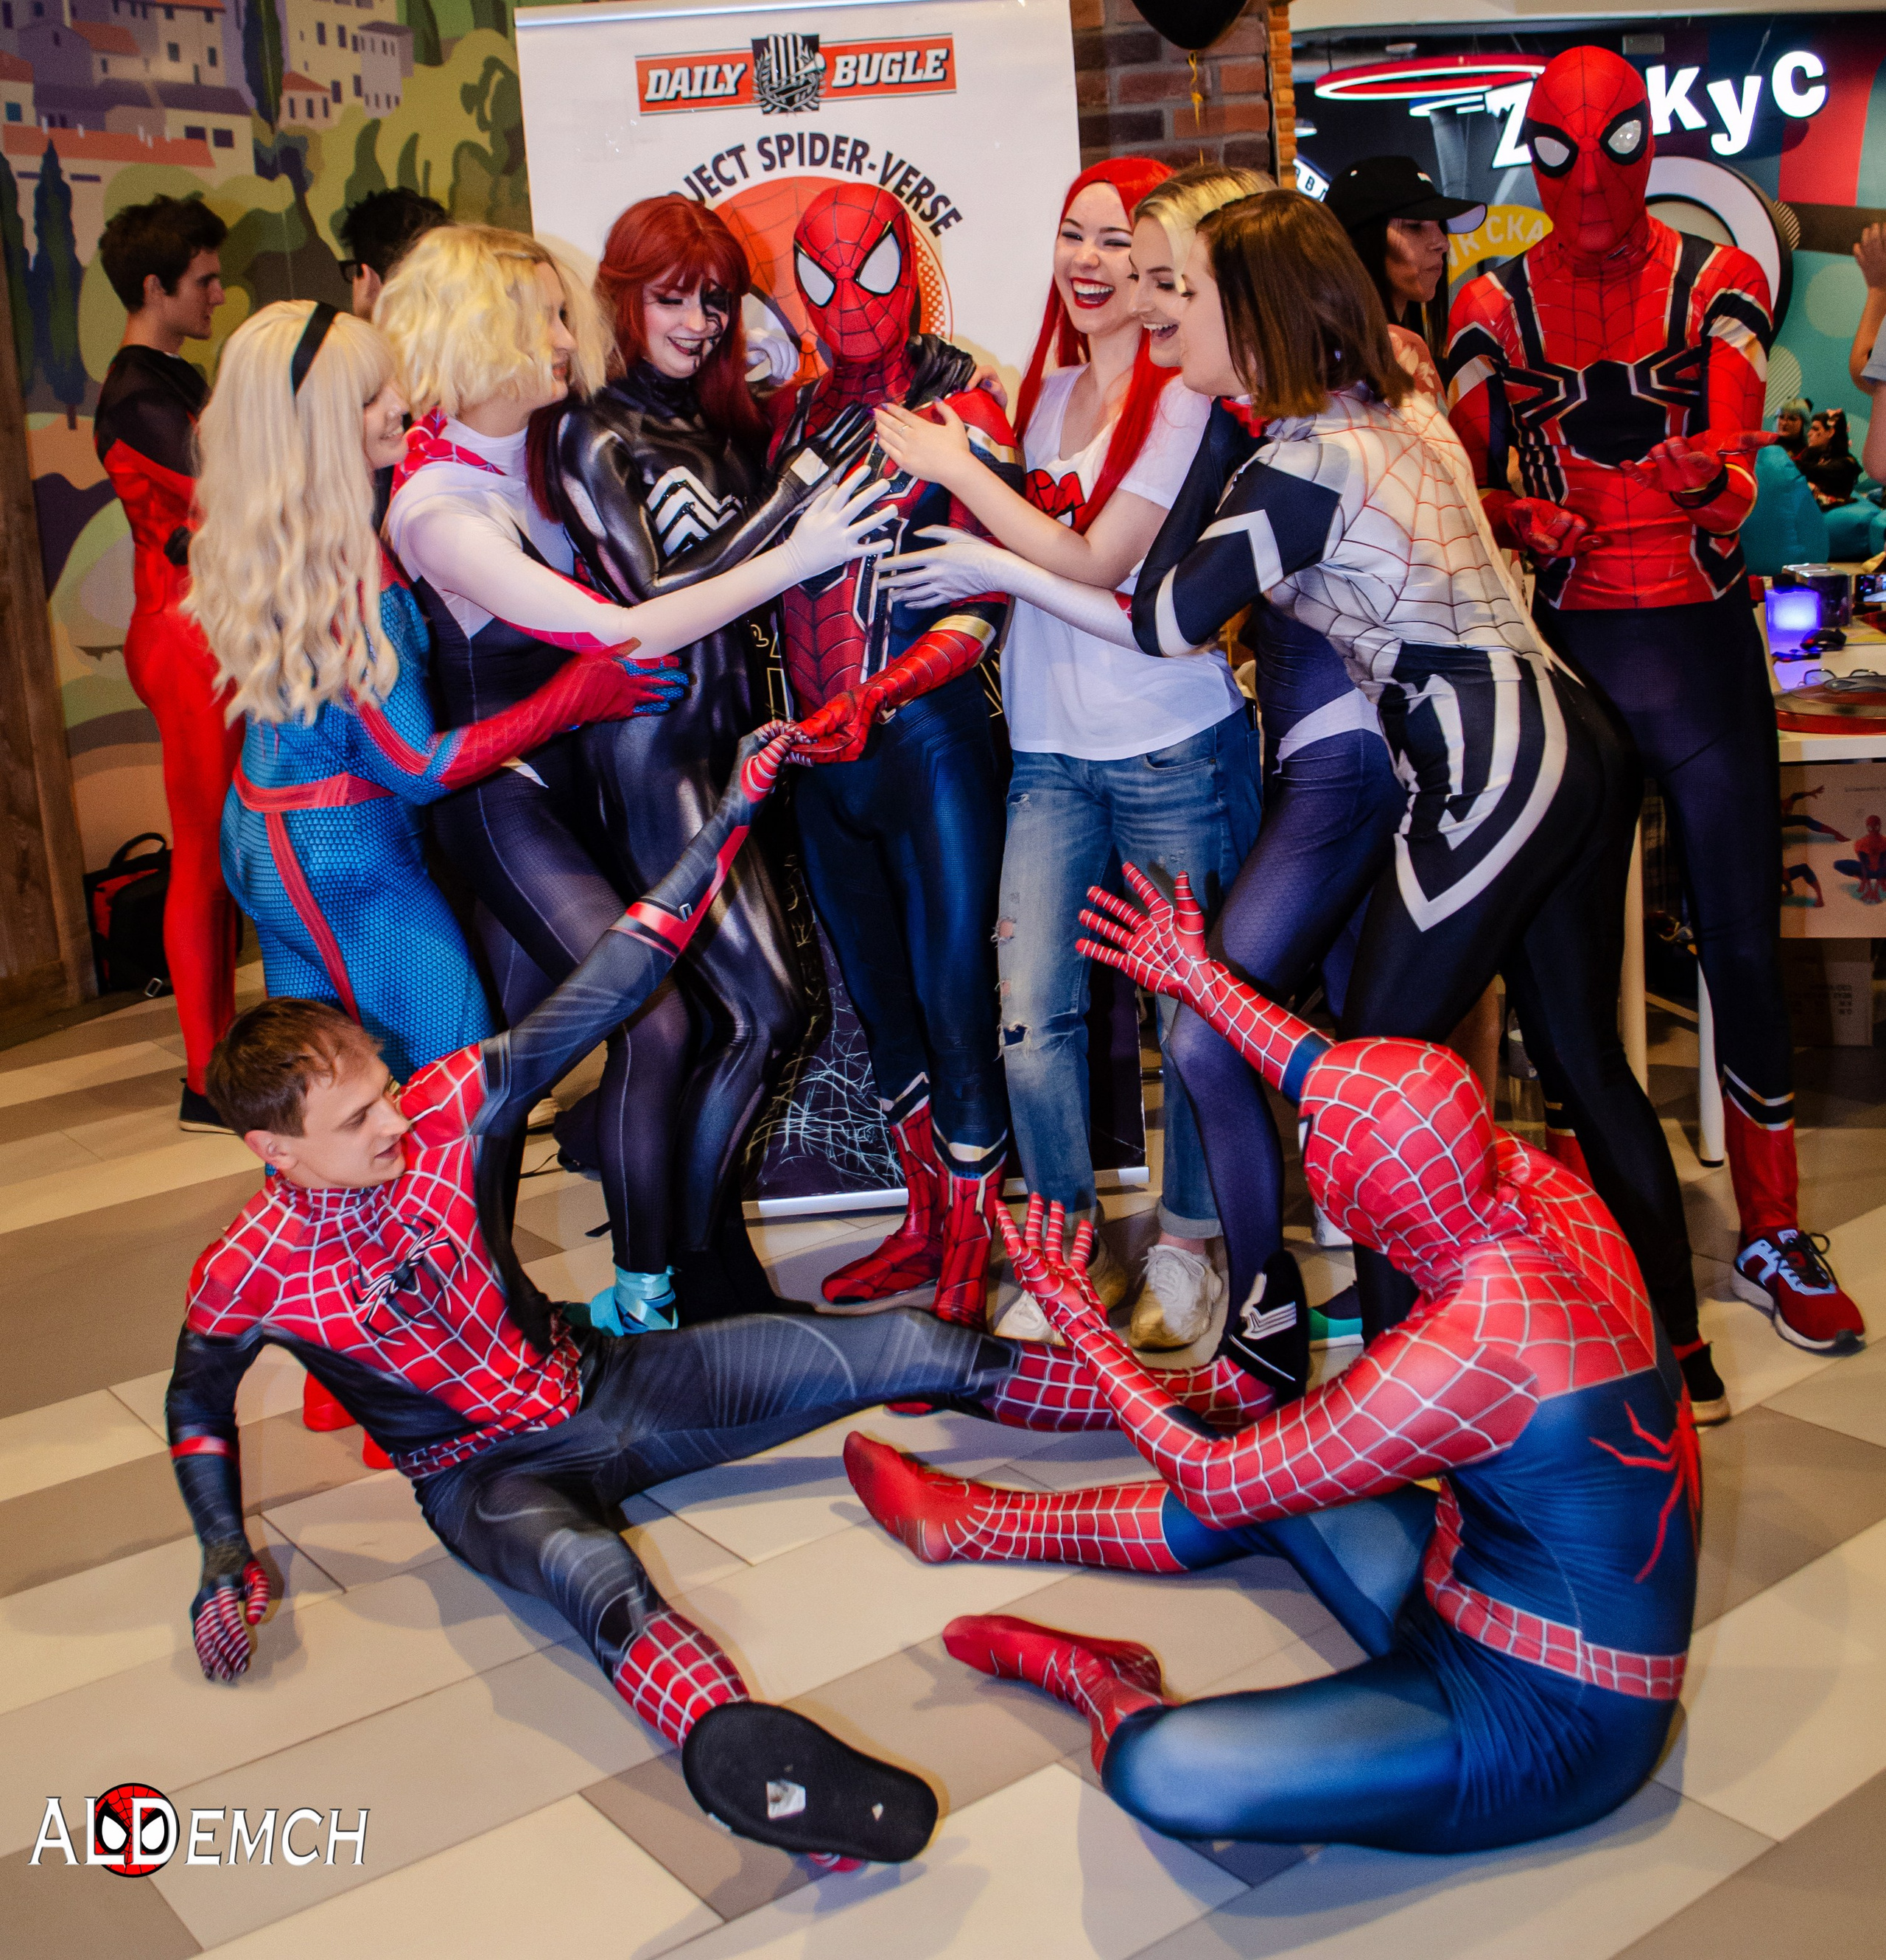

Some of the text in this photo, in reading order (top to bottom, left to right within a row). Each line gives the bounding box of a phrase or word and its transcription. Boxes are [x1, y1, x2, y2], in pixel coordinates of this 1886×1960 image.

[645, 63, 746, 102] DAILY
[832, 48, 950, 88] BUGLE
[667, 130, 964, 238] JECT SPIDER-VERSE
